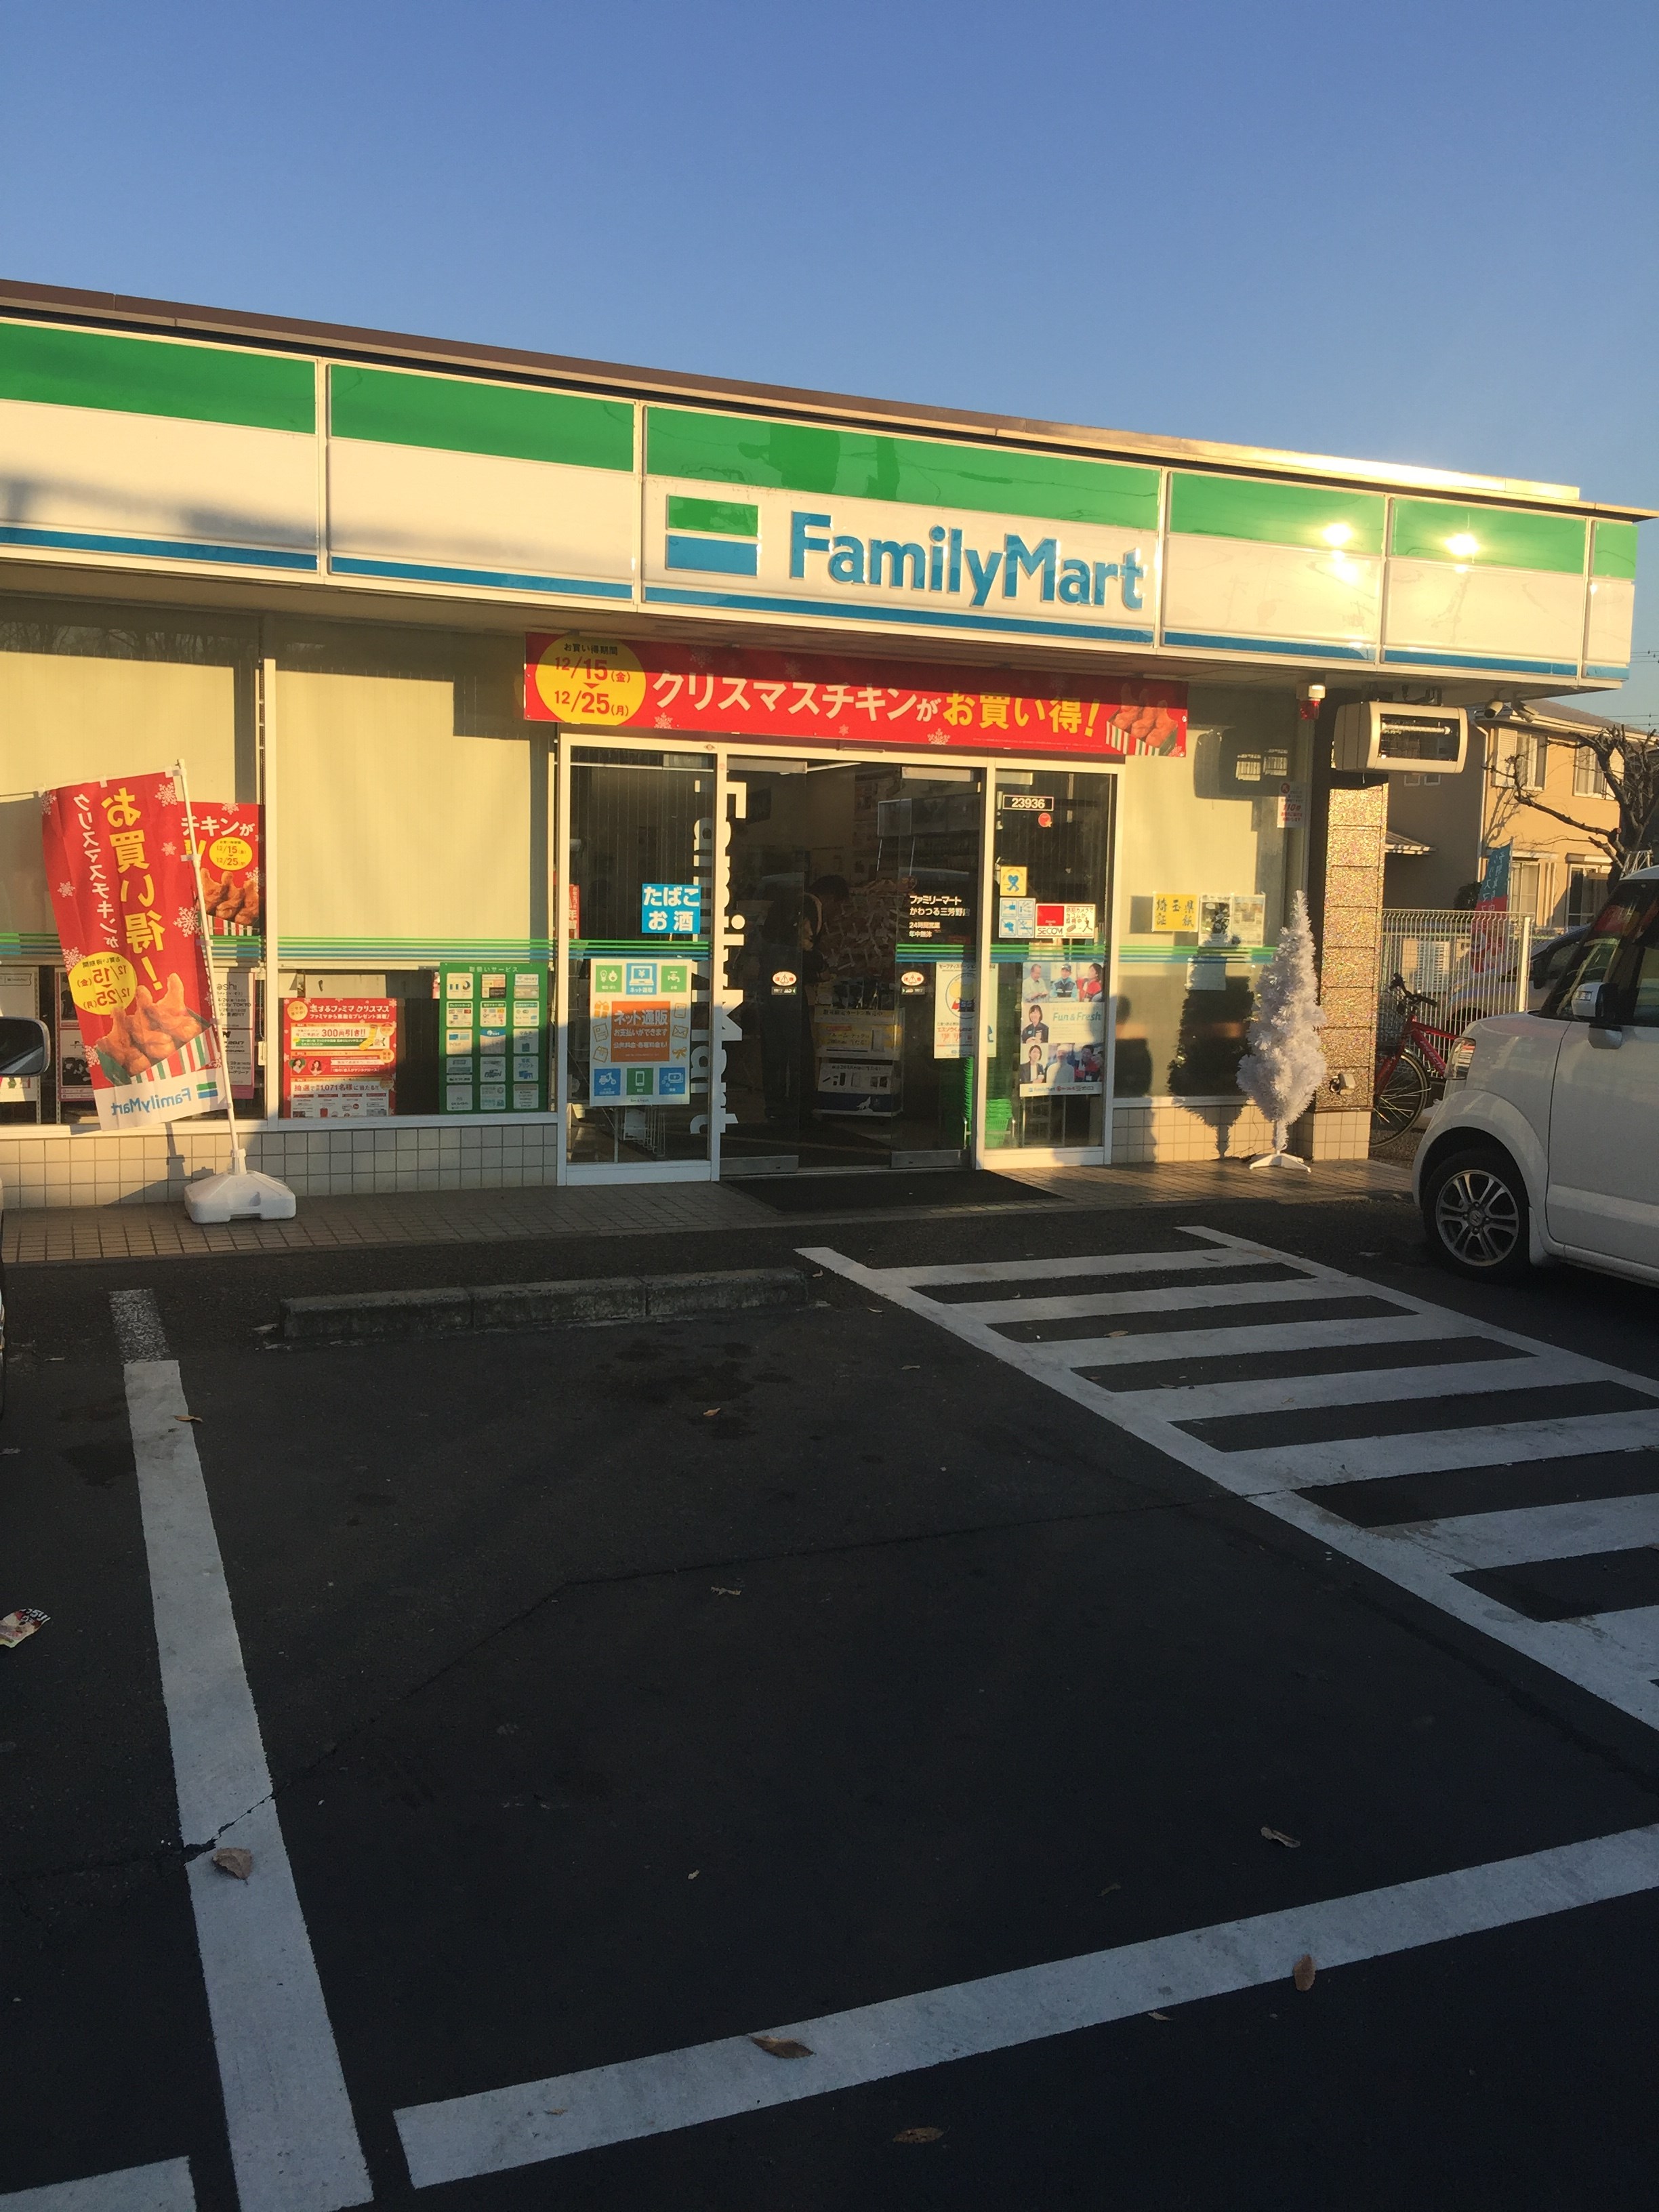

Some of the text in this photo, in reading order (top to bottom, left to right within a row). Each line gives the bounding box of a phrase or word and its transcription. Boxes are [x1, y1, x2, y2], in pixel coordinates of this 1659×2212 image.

[790, 510, 1145, 611] FamilyMart
[564, 642, 618, 655] お買い得期間
[1011, 797, 1045, 808] 23936
[643, 886, 700, 907] たばこ
[909, 895, 962, 905] ファミリーマート
[1156, 897, 1195, 914] 埼玉県
[648, 911, 694, 932] お酒
[1037, 927, 1063, 935] SECOM
[613, 1009, 668, 1025] ネット通販
[1052, 1012, 1069, 1021] Fun
[1076, 1011, 1101, 1021] Fresh
